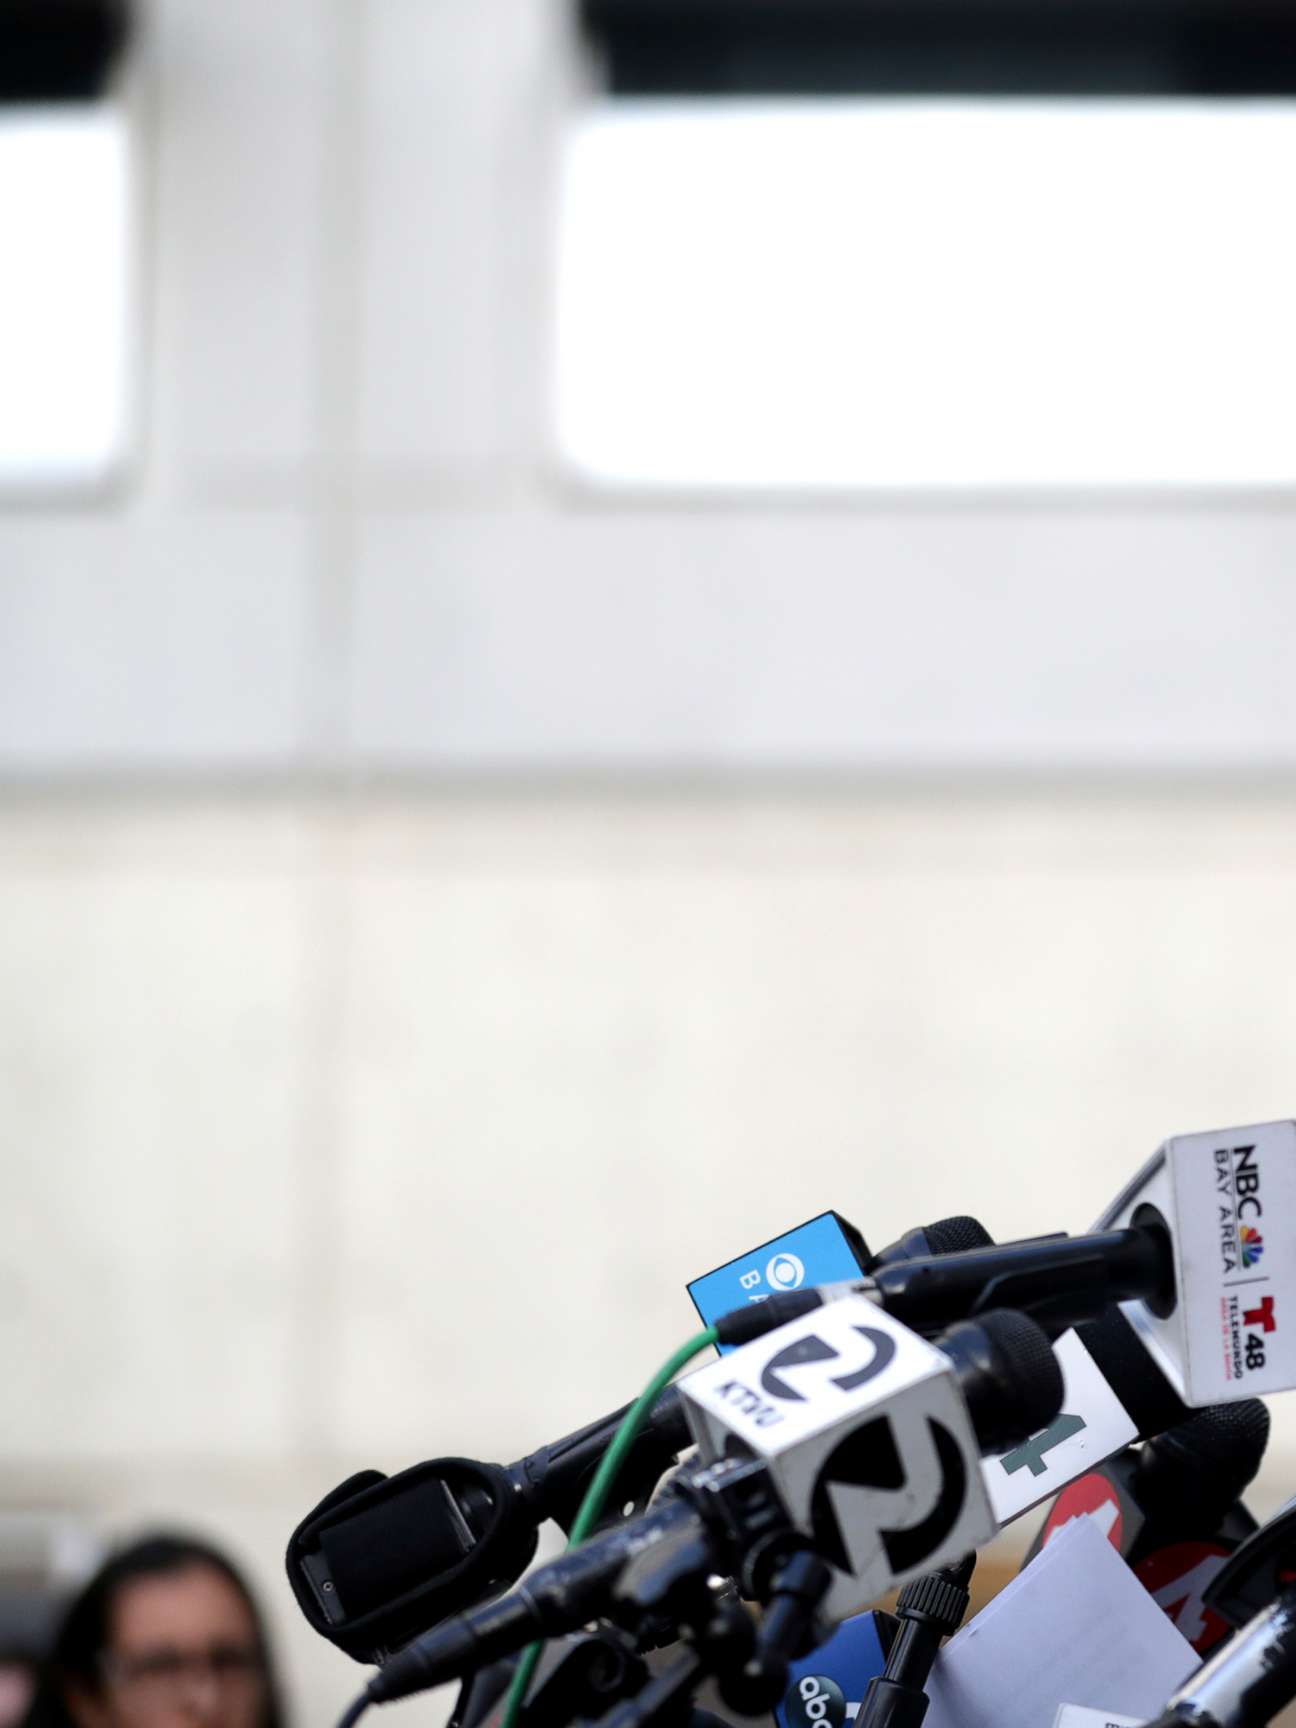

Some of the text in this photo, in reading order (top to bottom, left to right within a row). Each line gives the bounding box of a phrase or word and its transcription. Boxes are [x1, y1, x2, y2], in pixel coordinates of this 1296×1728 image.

[1214, 1149, 1233, 1196] BAY
[1233, 1144, 1263, 1220] NBC
[1219, 1206, 1237, 1274] AREA
[1229, 1295, 1243, 1379] TELEMUNDO
[1245, 1333, 1266, 1371] 48
